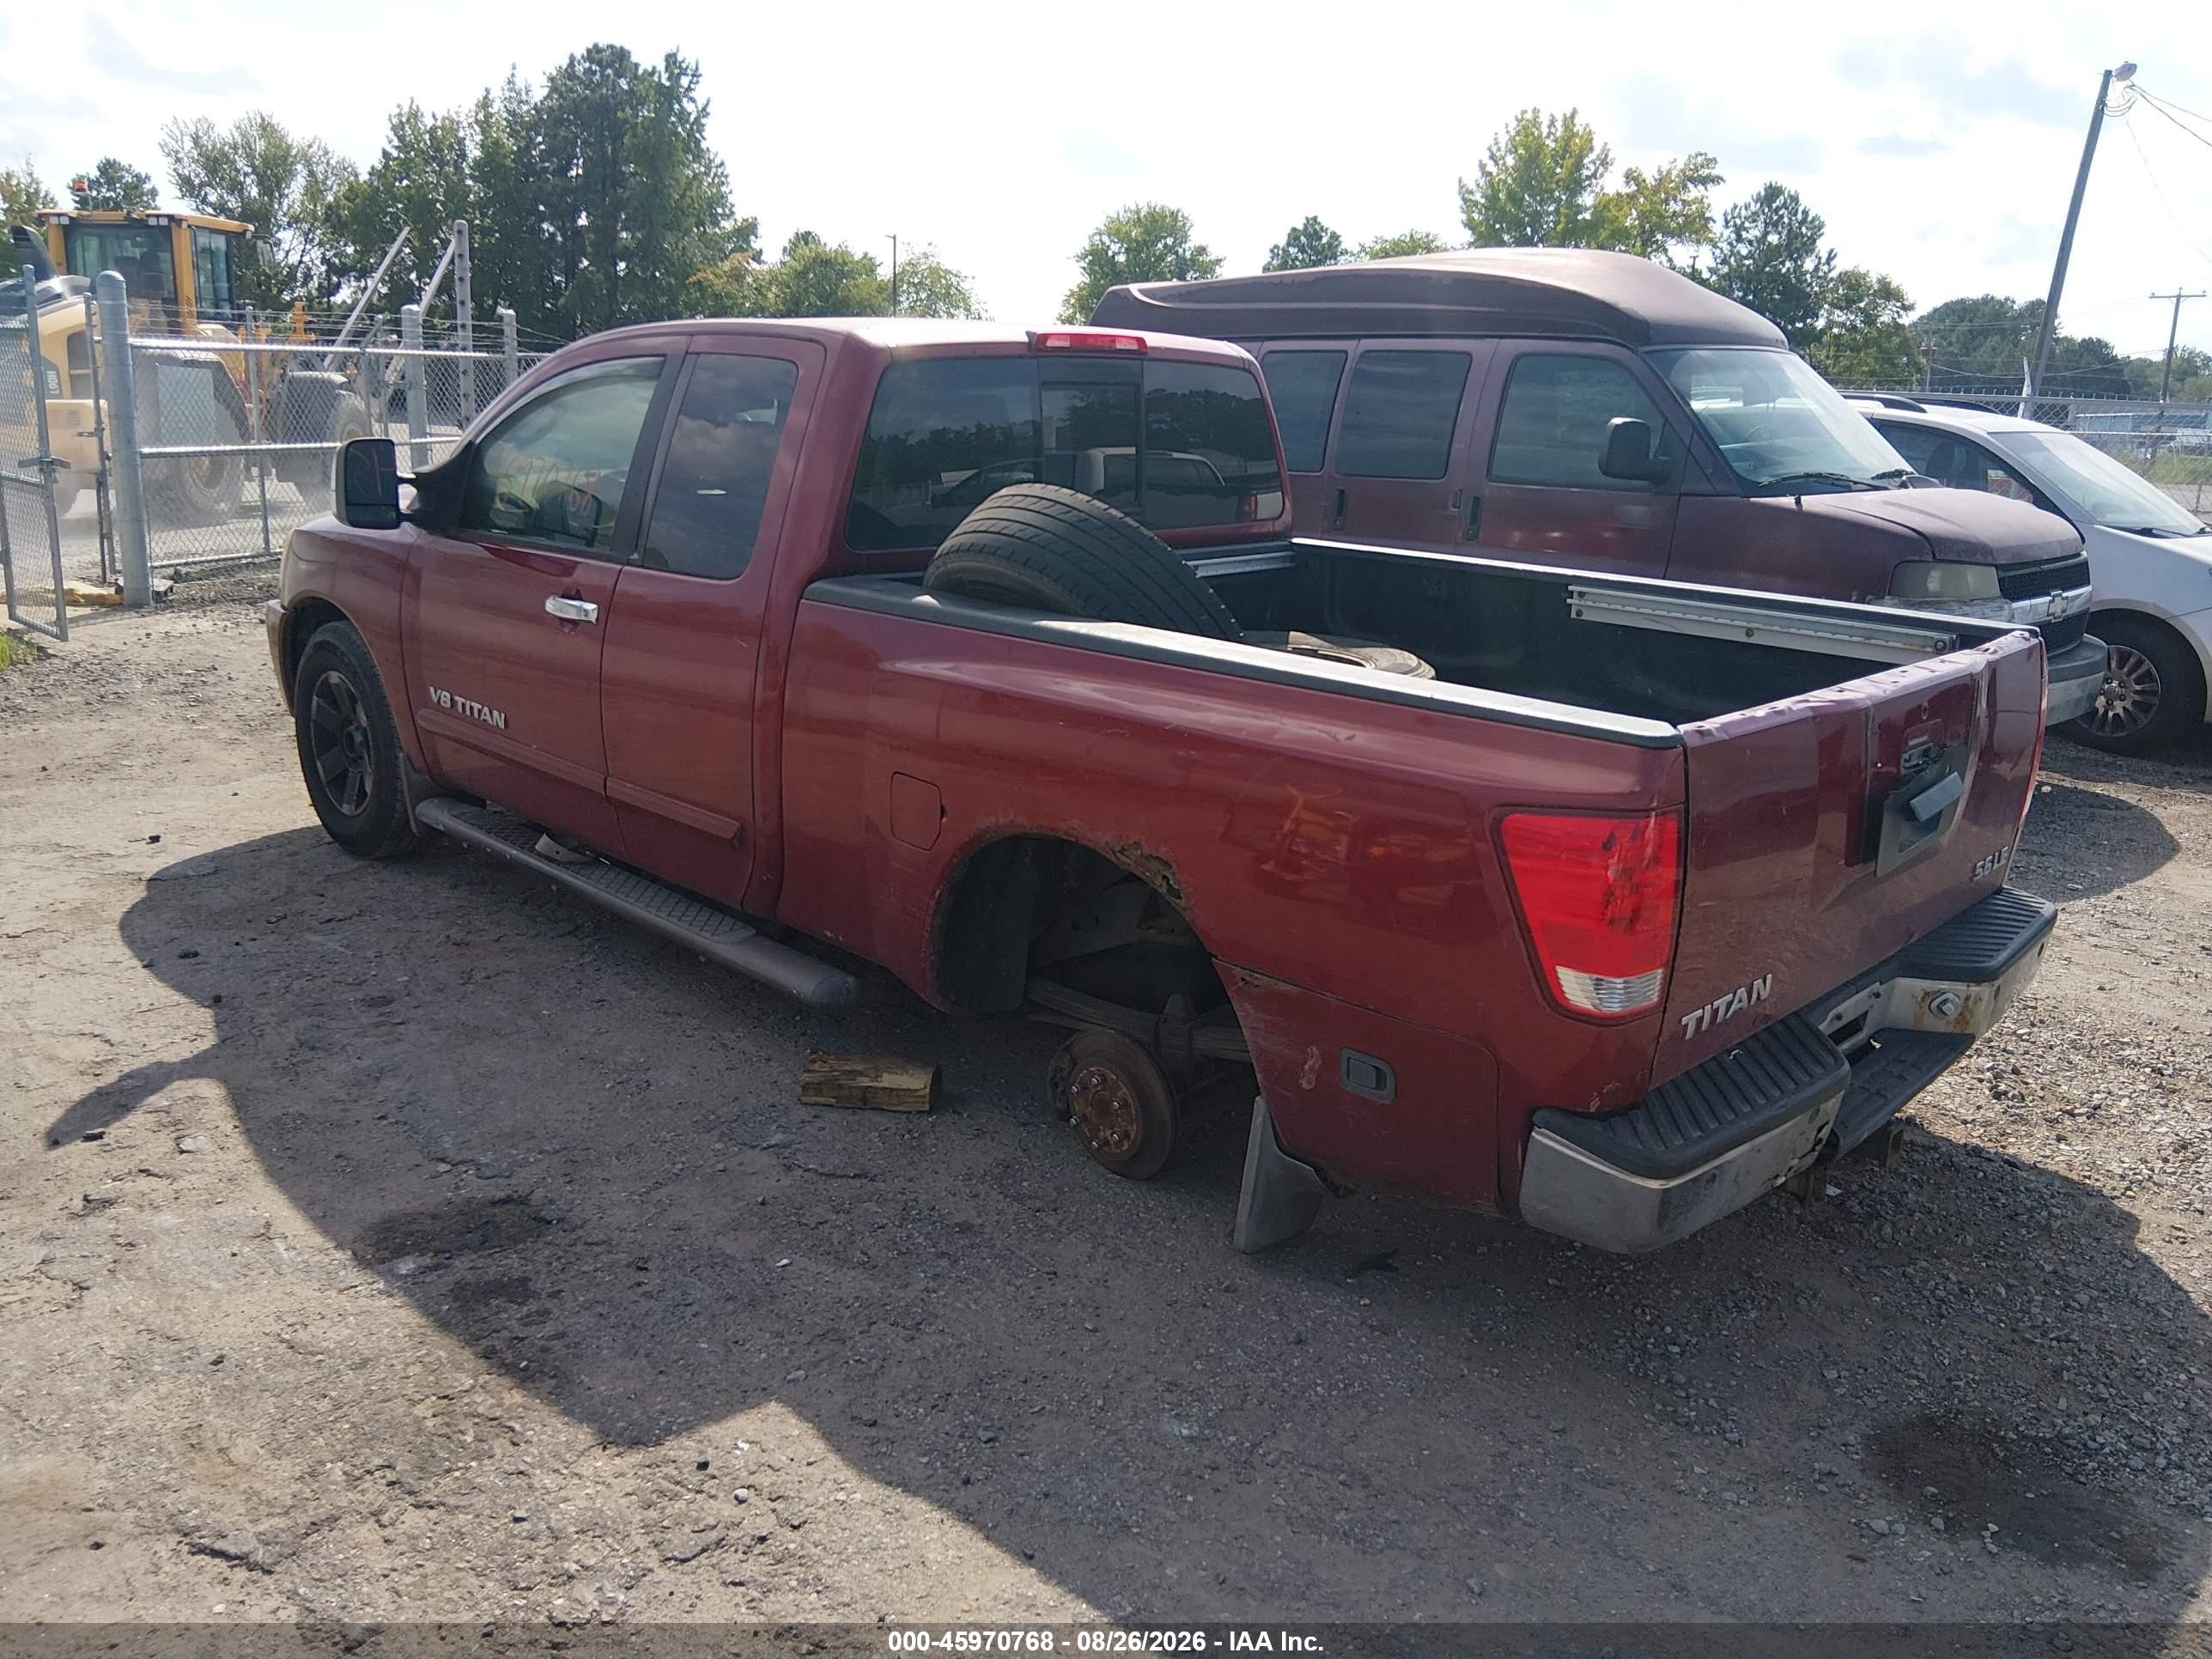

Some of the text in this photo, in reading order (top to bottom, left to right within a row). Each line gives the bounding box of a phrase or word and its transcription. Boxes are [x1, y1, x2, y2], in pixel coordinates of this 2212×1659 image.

[428, 686, 507, 730] V8 TITAN
[1680, 973, 1773, 1041] TITAN
